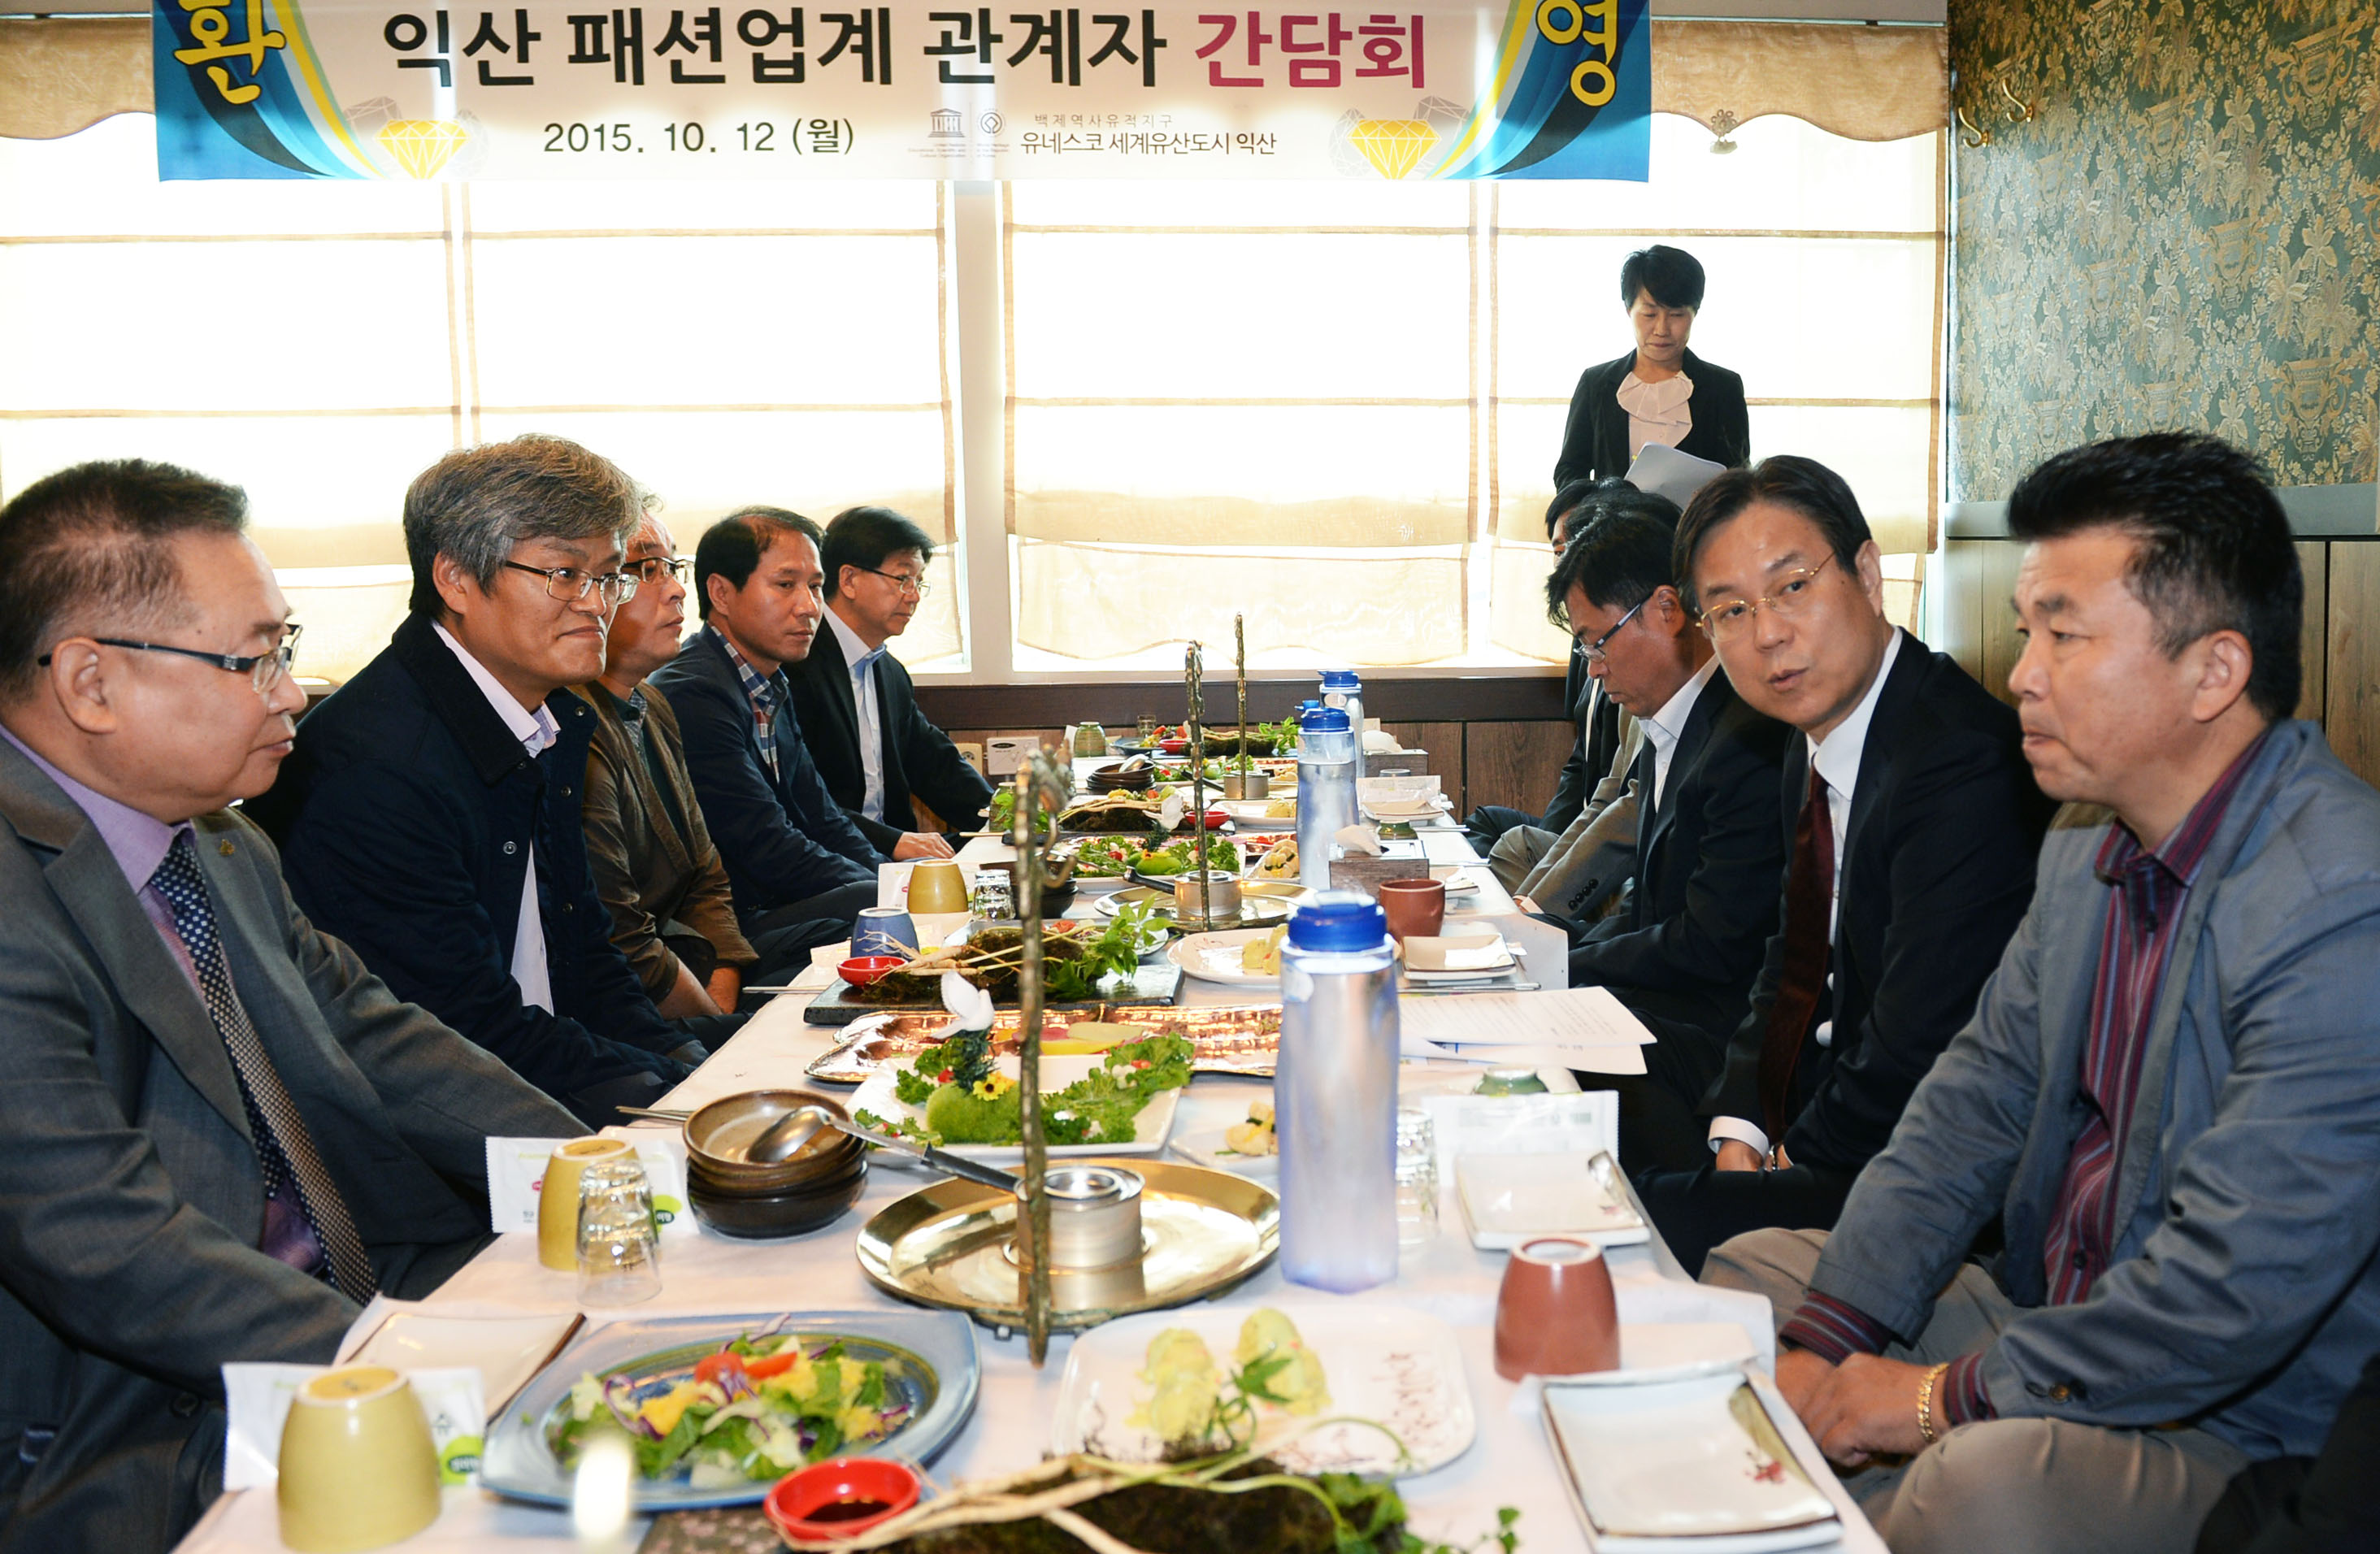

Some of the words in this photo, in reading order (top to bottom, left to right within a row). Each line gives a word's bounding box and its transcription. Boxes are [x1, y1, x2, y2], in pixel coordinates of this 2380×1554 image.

[173, 0, 287, 105] 환
[383, 8, 541, 88] 익산
[567, 7, 892, 86] 패션업계
[923, 7, 1167, 87] 관계자
[1195, 11, 1425, 89] 간담회
[1535, 0, 1618, 107] 영
[543, 122, 645, 154] 2015.
[663, 121, 717, 154] 10.
[736, 121, 775, 152] 12
[792, 117, 854, 155] (월)
[1020, 132, 1105, 154] 유네스코
[1109, 132, 1230, 155] 세계유산도시
[1236, 132, 1278, 155] 익산
